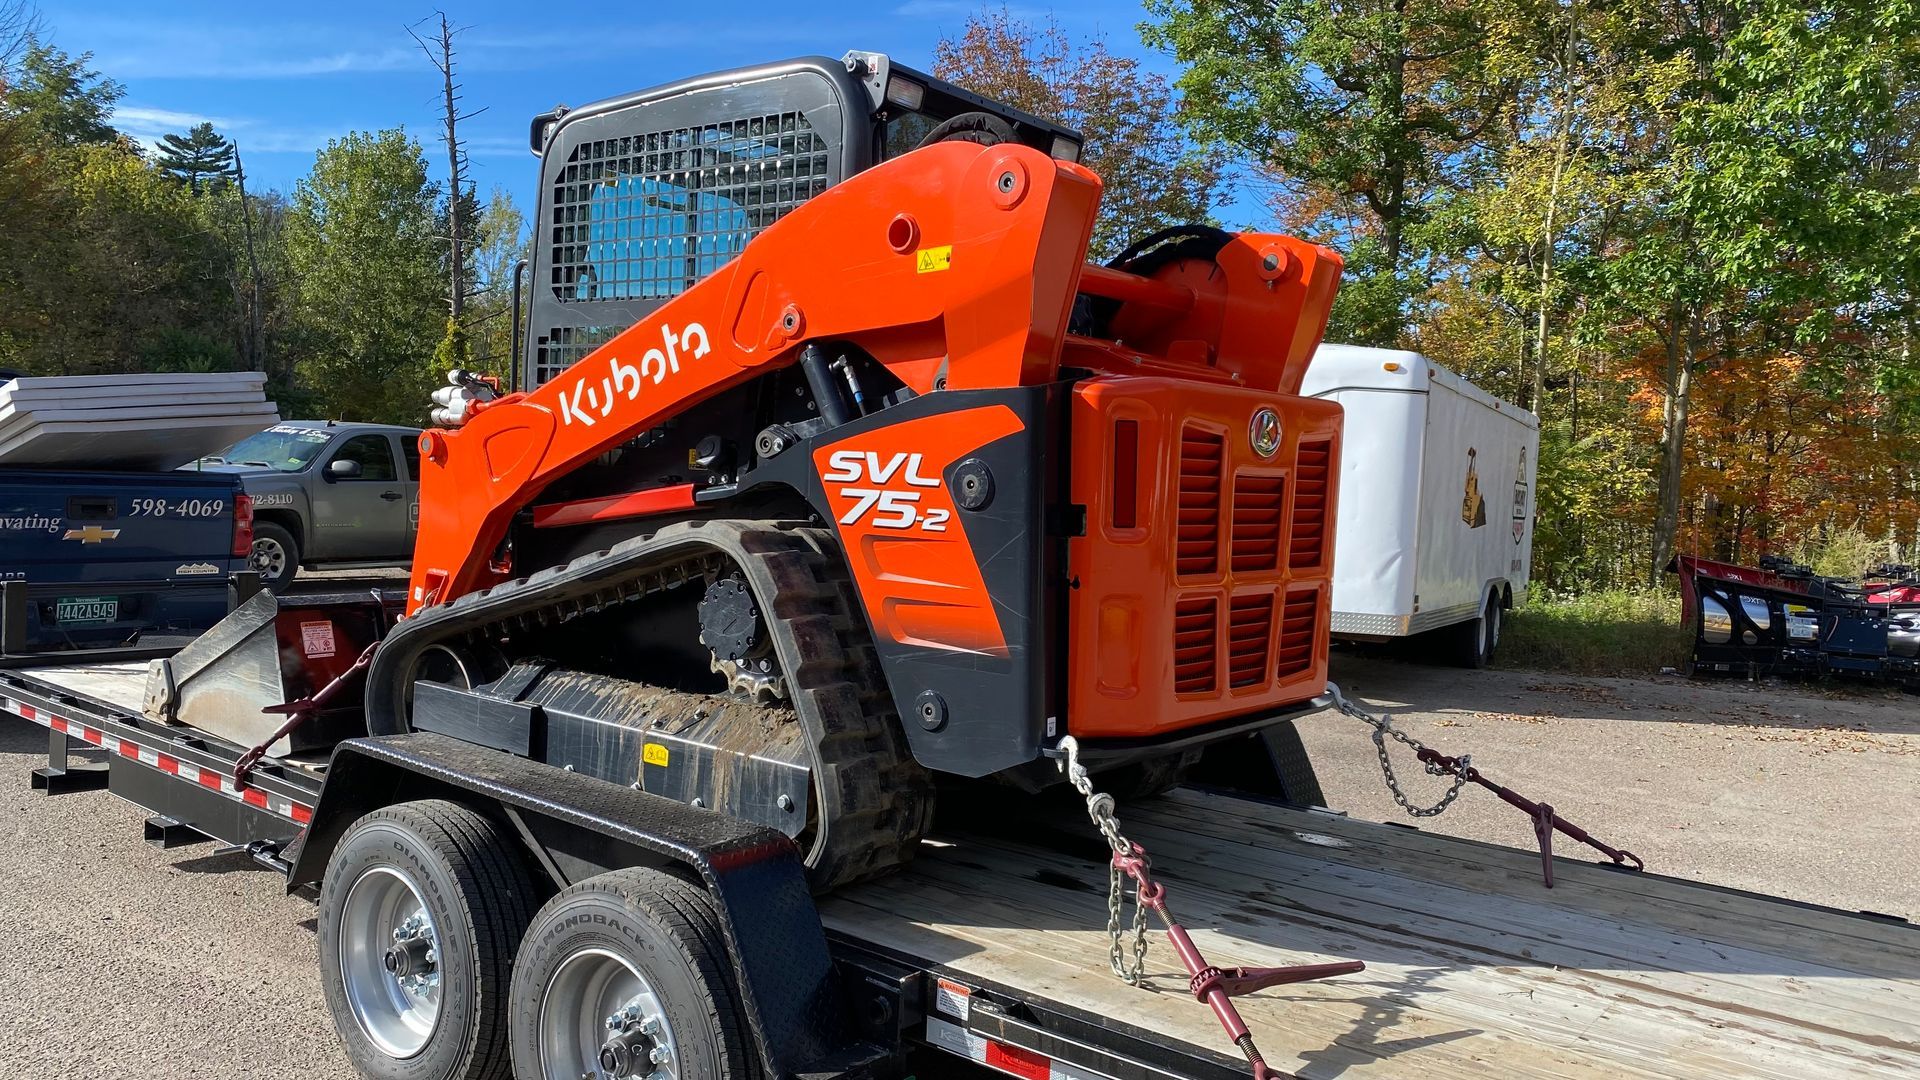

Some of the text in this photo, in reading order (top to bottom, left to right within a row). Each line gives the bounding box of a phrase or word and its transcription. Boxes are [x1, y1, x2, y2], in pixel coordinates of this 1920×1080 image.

[558, 322, 711, 426] Kubota
[823, 450, 941, 487] SVL
[128, 498, 224, 517] 598-4069
[839, 488, 950, 532] 75-2
[63, 603, 115, 620] 442A949
